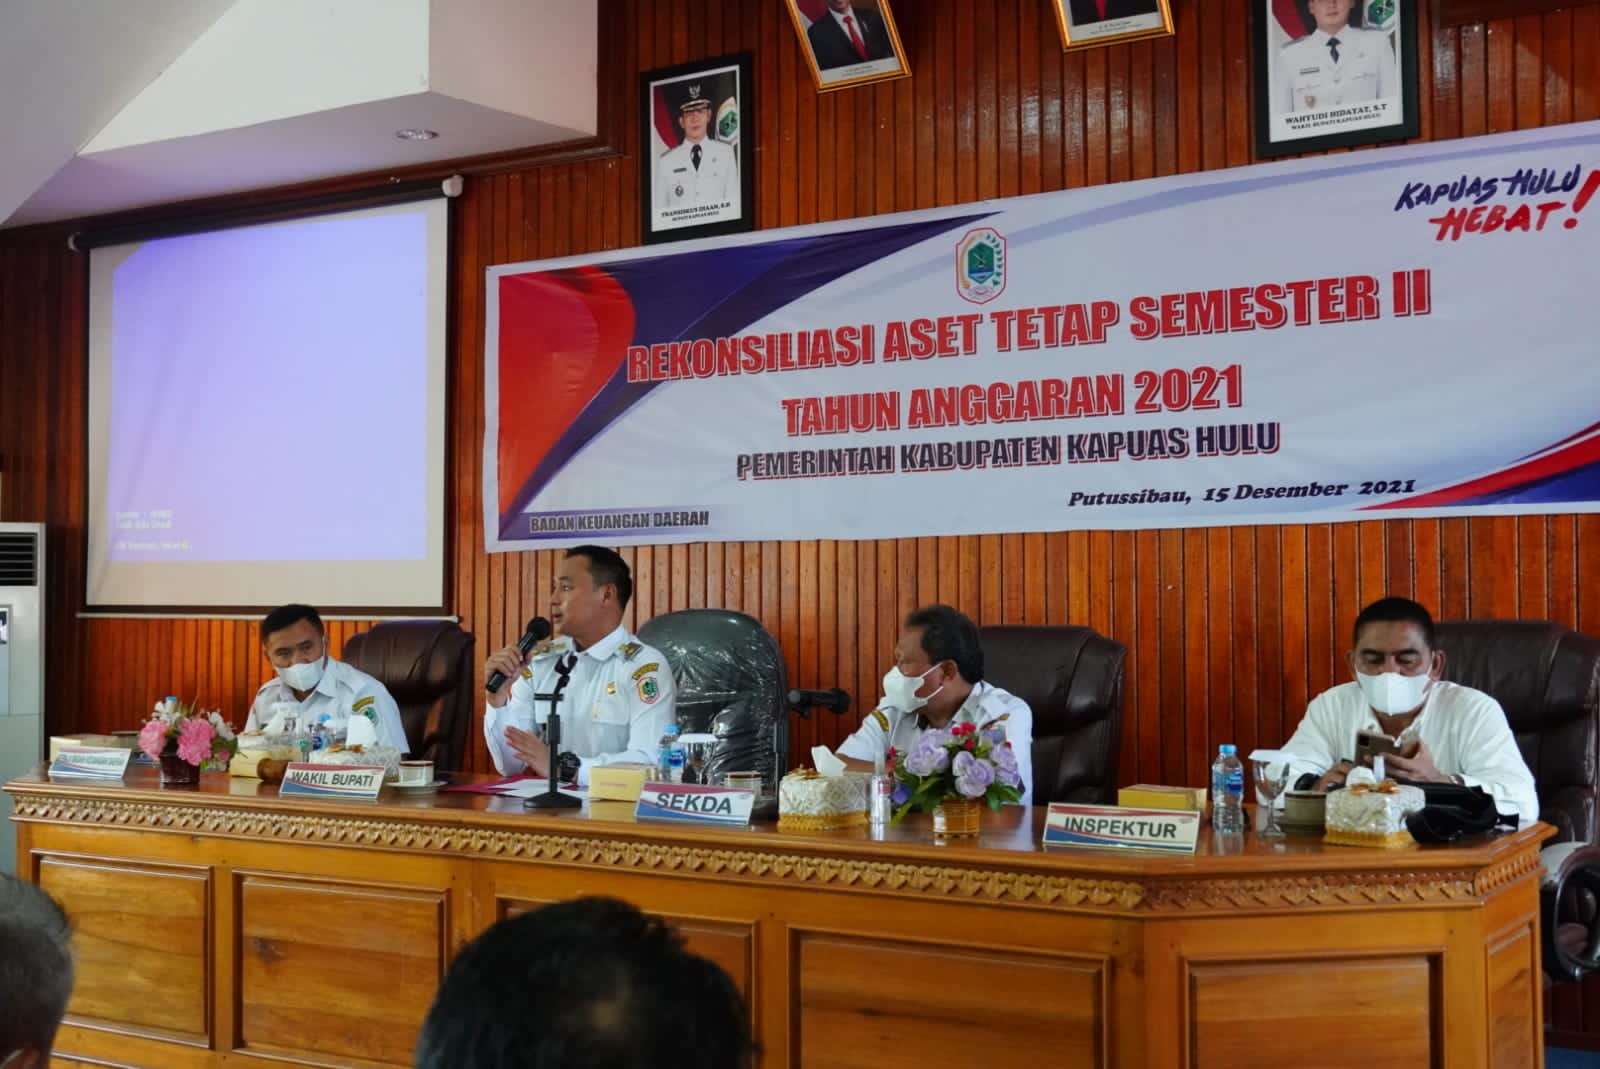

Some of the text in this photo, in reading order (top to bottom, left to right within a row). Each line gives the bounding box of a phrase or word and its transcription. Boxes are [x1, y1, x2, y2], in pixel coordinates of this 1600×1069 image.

[1394, 163, 1582, 212] KAPUAS HULU
[626, 268, 1431, 383] REKONSILIASI ASET TETAP SEMESTER II
[781, 364, 1242, 436] TAHUN ANGGARAN 2021
[736, 421, 1281, 480] PEMERINTAH KABUPATEN KAPUAS HULU
[1067, 479, 1416, 507] Putussibau, 15 Desember 2021
[530, 511, 710, 532] BADAN KEUANGAN DAERAH
[291, 770, 375, 787] WAKIL BUPATI
[656, 793, 733, 815] SEKDA
[1063, 816, 1177, 839] INSPEKTUR
